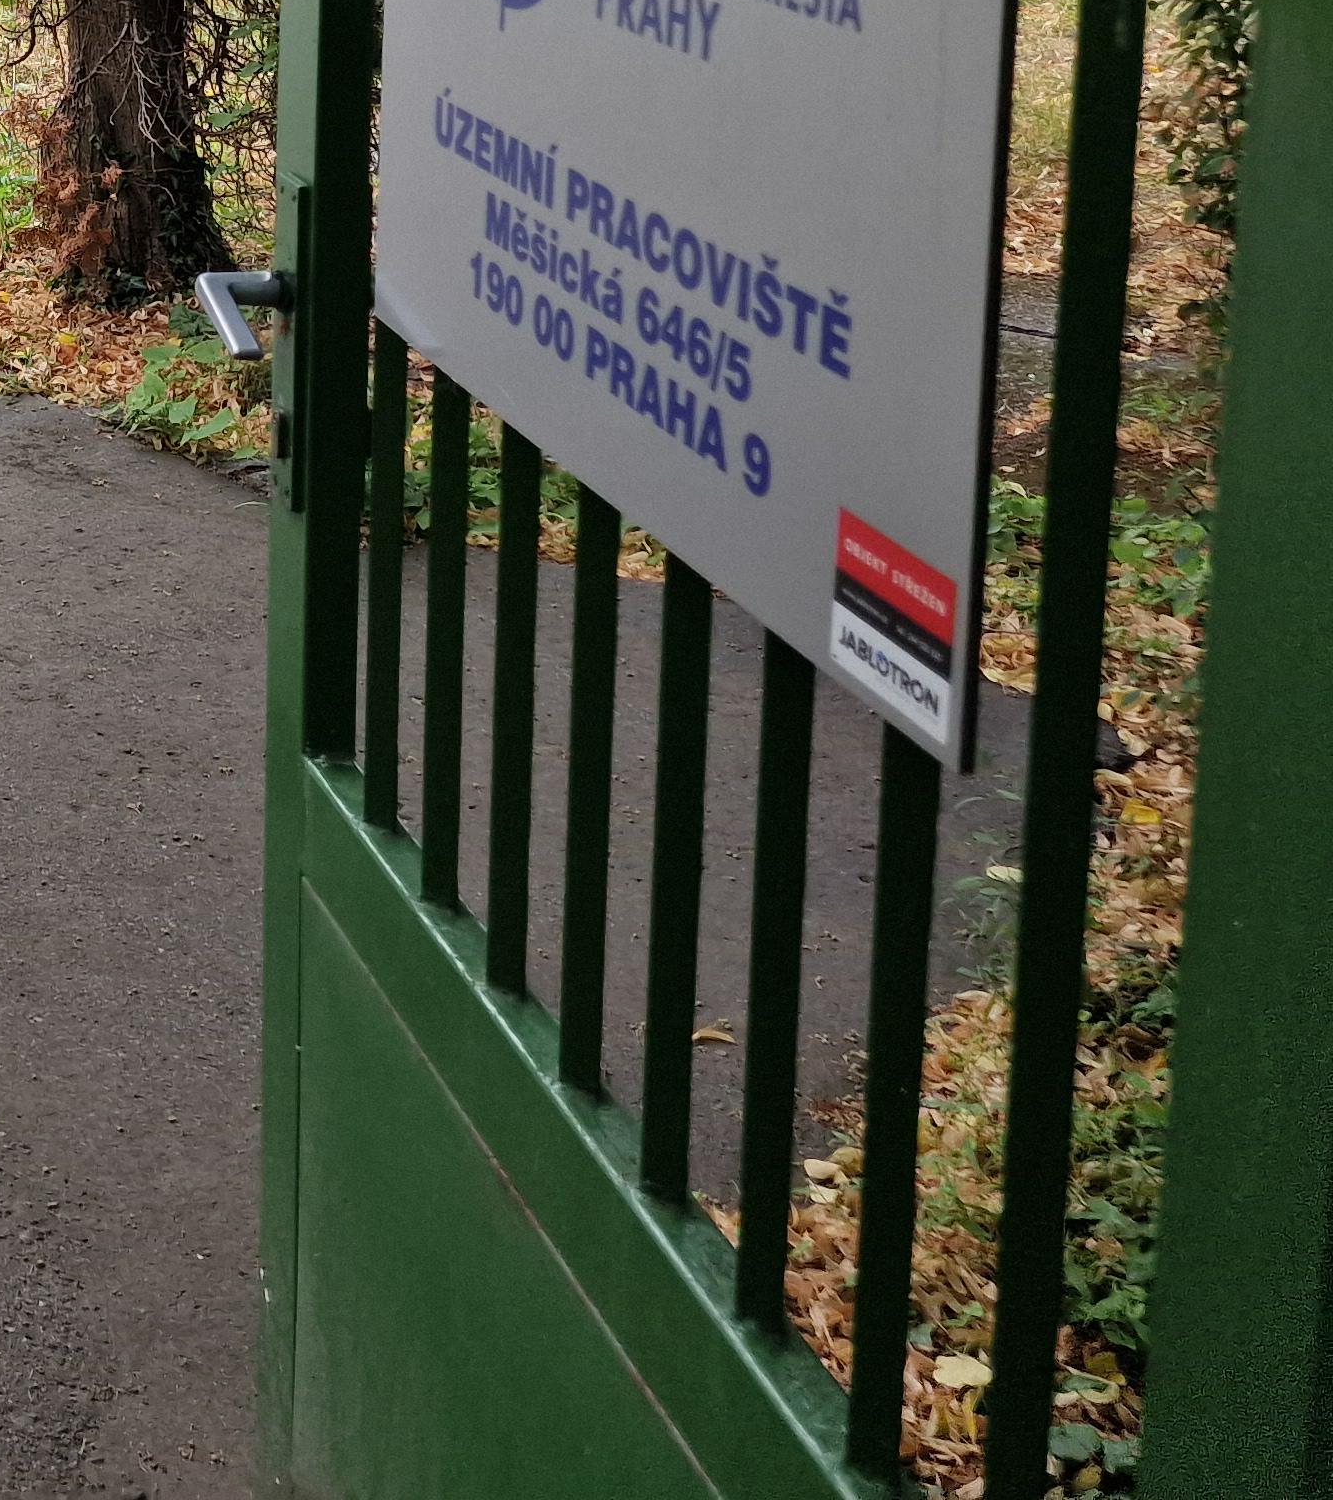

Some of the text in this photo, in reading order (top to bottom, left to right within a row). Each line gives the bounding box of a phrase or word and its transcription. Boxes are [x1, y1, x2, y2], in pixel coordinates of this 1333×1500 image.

[434, 86, 853, 381] ÚZEMNÍ PRACOVIŠTĚ
[485, 190, 753, 402] Měšická 646/5
[470, 251, 772, 497] 190 00 PRAHA 9
[837, 625, 940, 717] JABLOTRON
